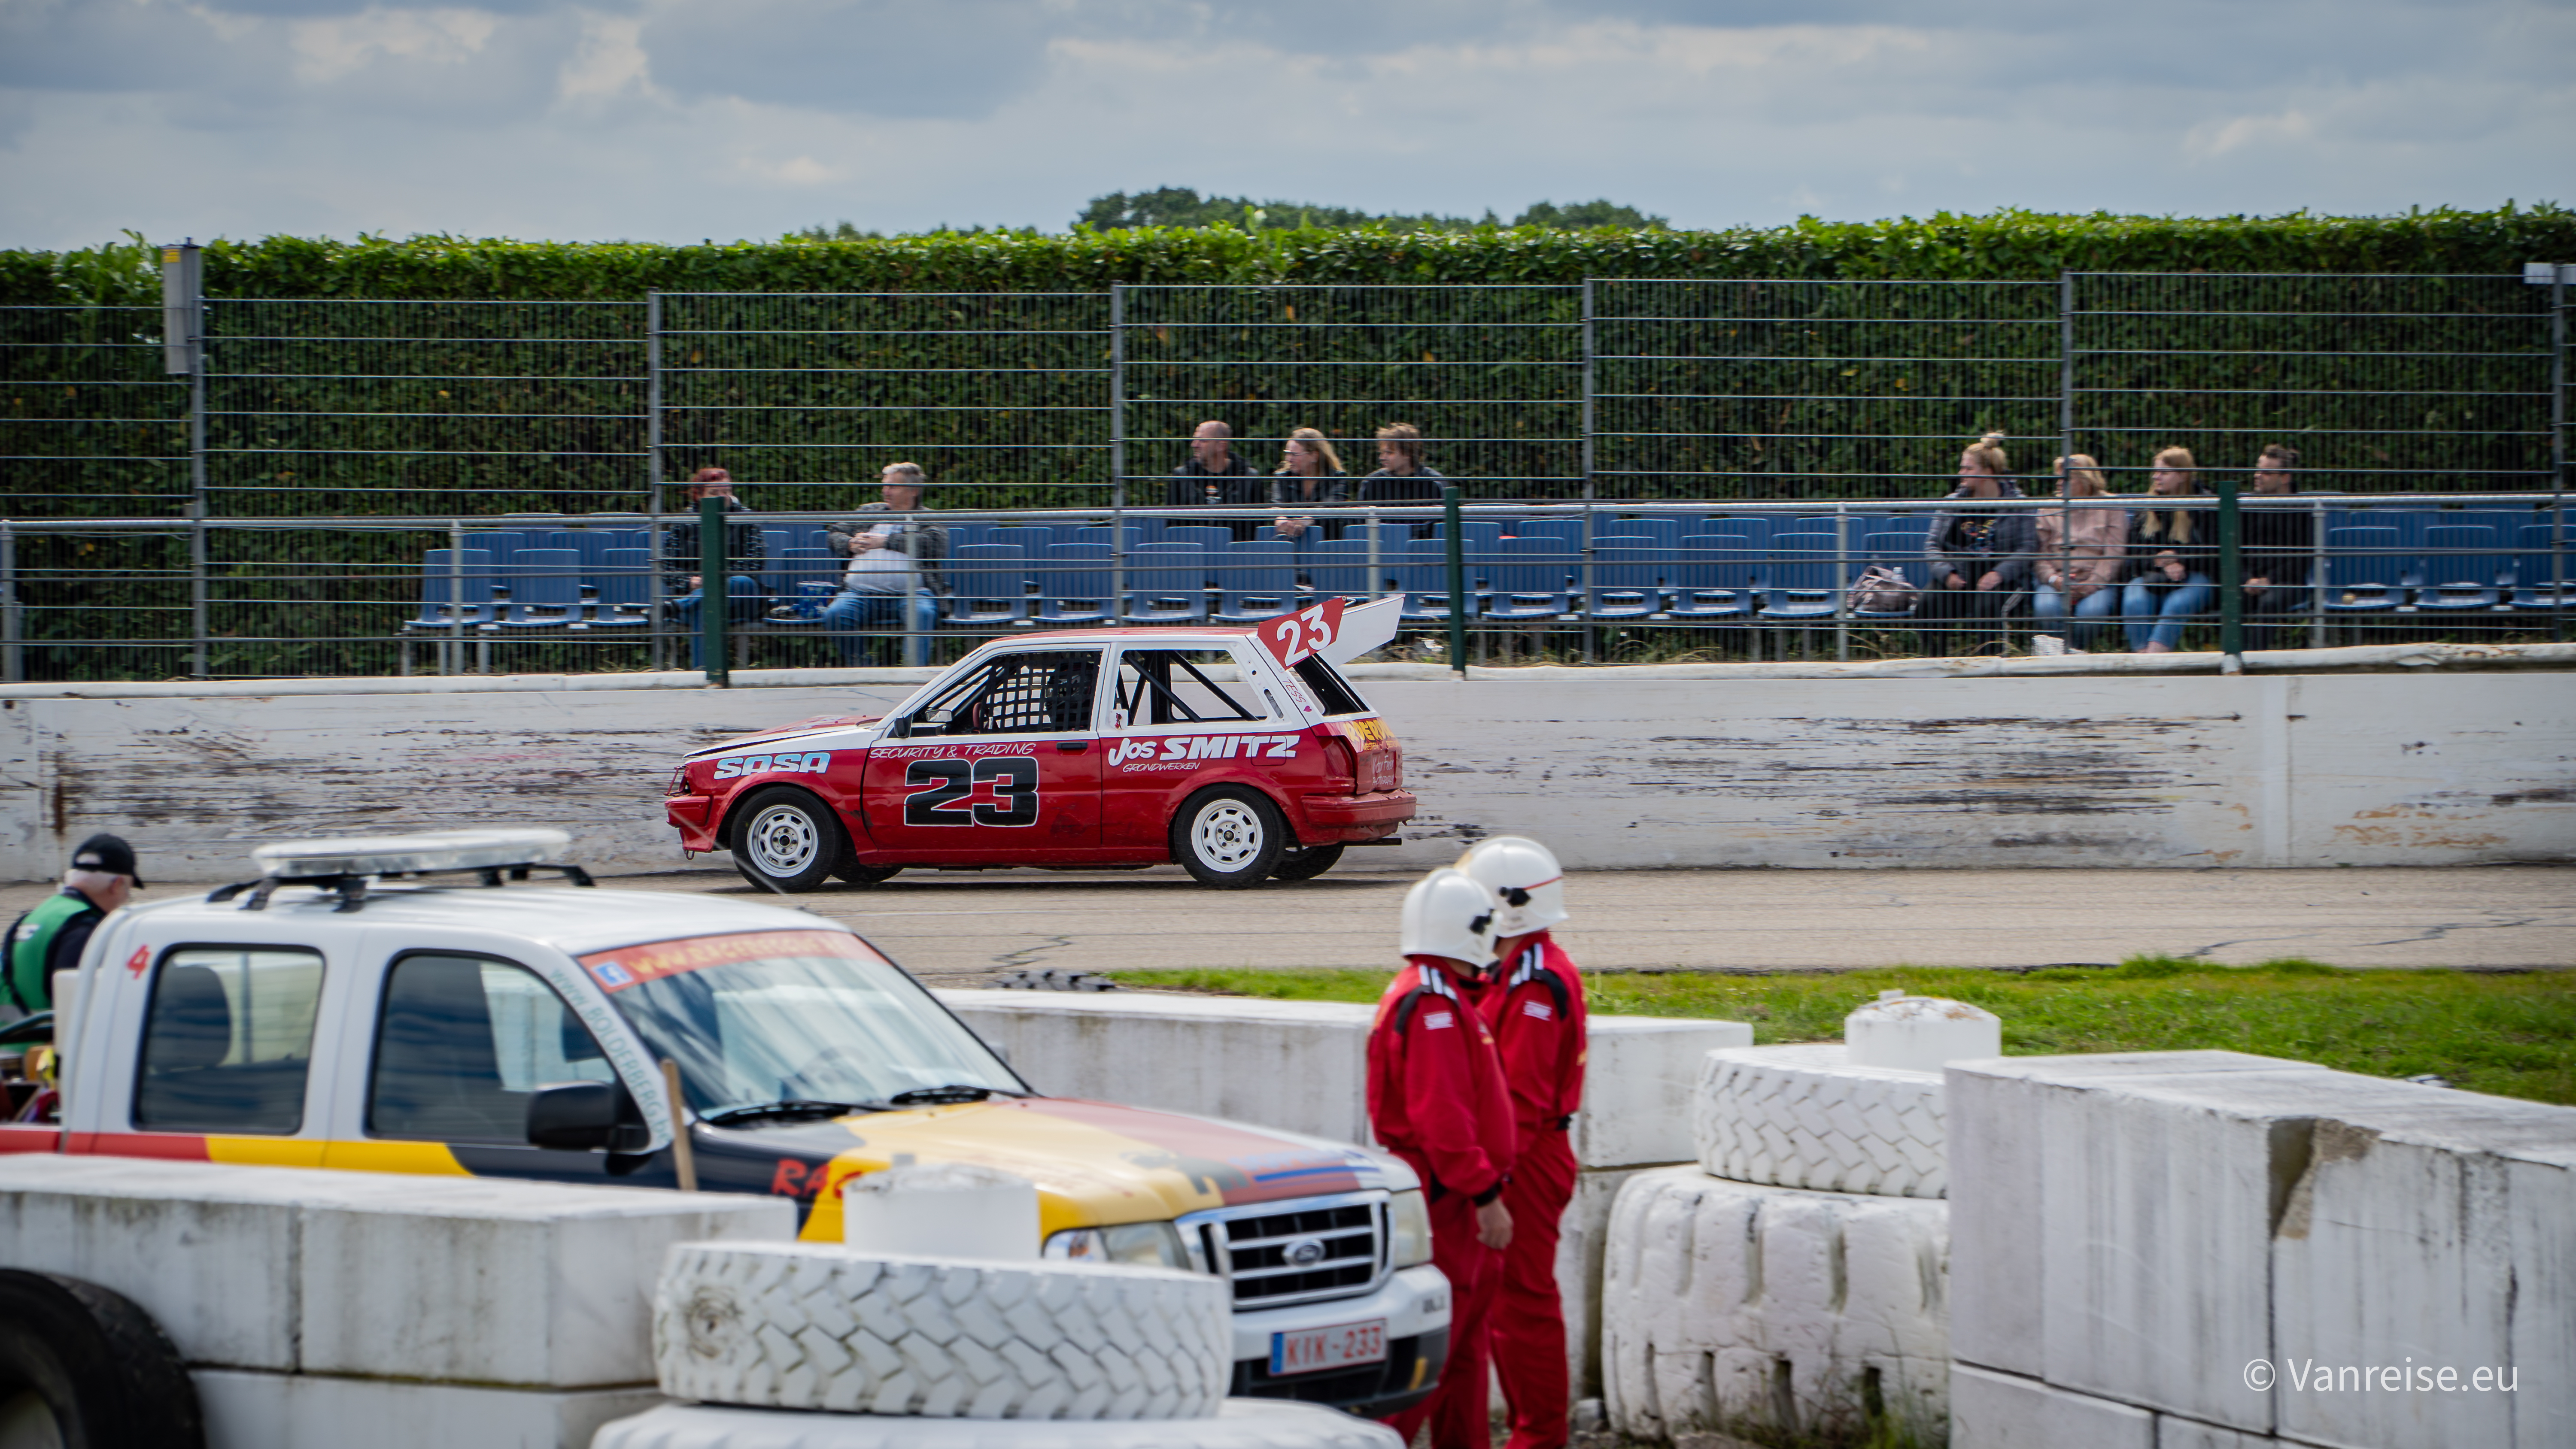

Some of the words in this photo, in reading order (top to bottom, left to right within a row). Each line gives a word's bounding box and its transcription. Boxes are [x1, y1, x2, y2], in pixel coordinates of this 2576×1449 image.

[1276, 603, 1331, 667] 23
[1282, 678, 1306, 703] TESS
[869, 746, 945, 758] SECURITY
[947, 746, 957, 758] &
[965, 743, 1036, 755] TRADING
[1159, 735, 1300, 761] SMITZ
[713, 752, 831, 780] SASA
[1122, 762, 1201, 773] GRONDWERKEN
[903, 756, 1039, 827] 23
[126, 944, 151, 980] 4
